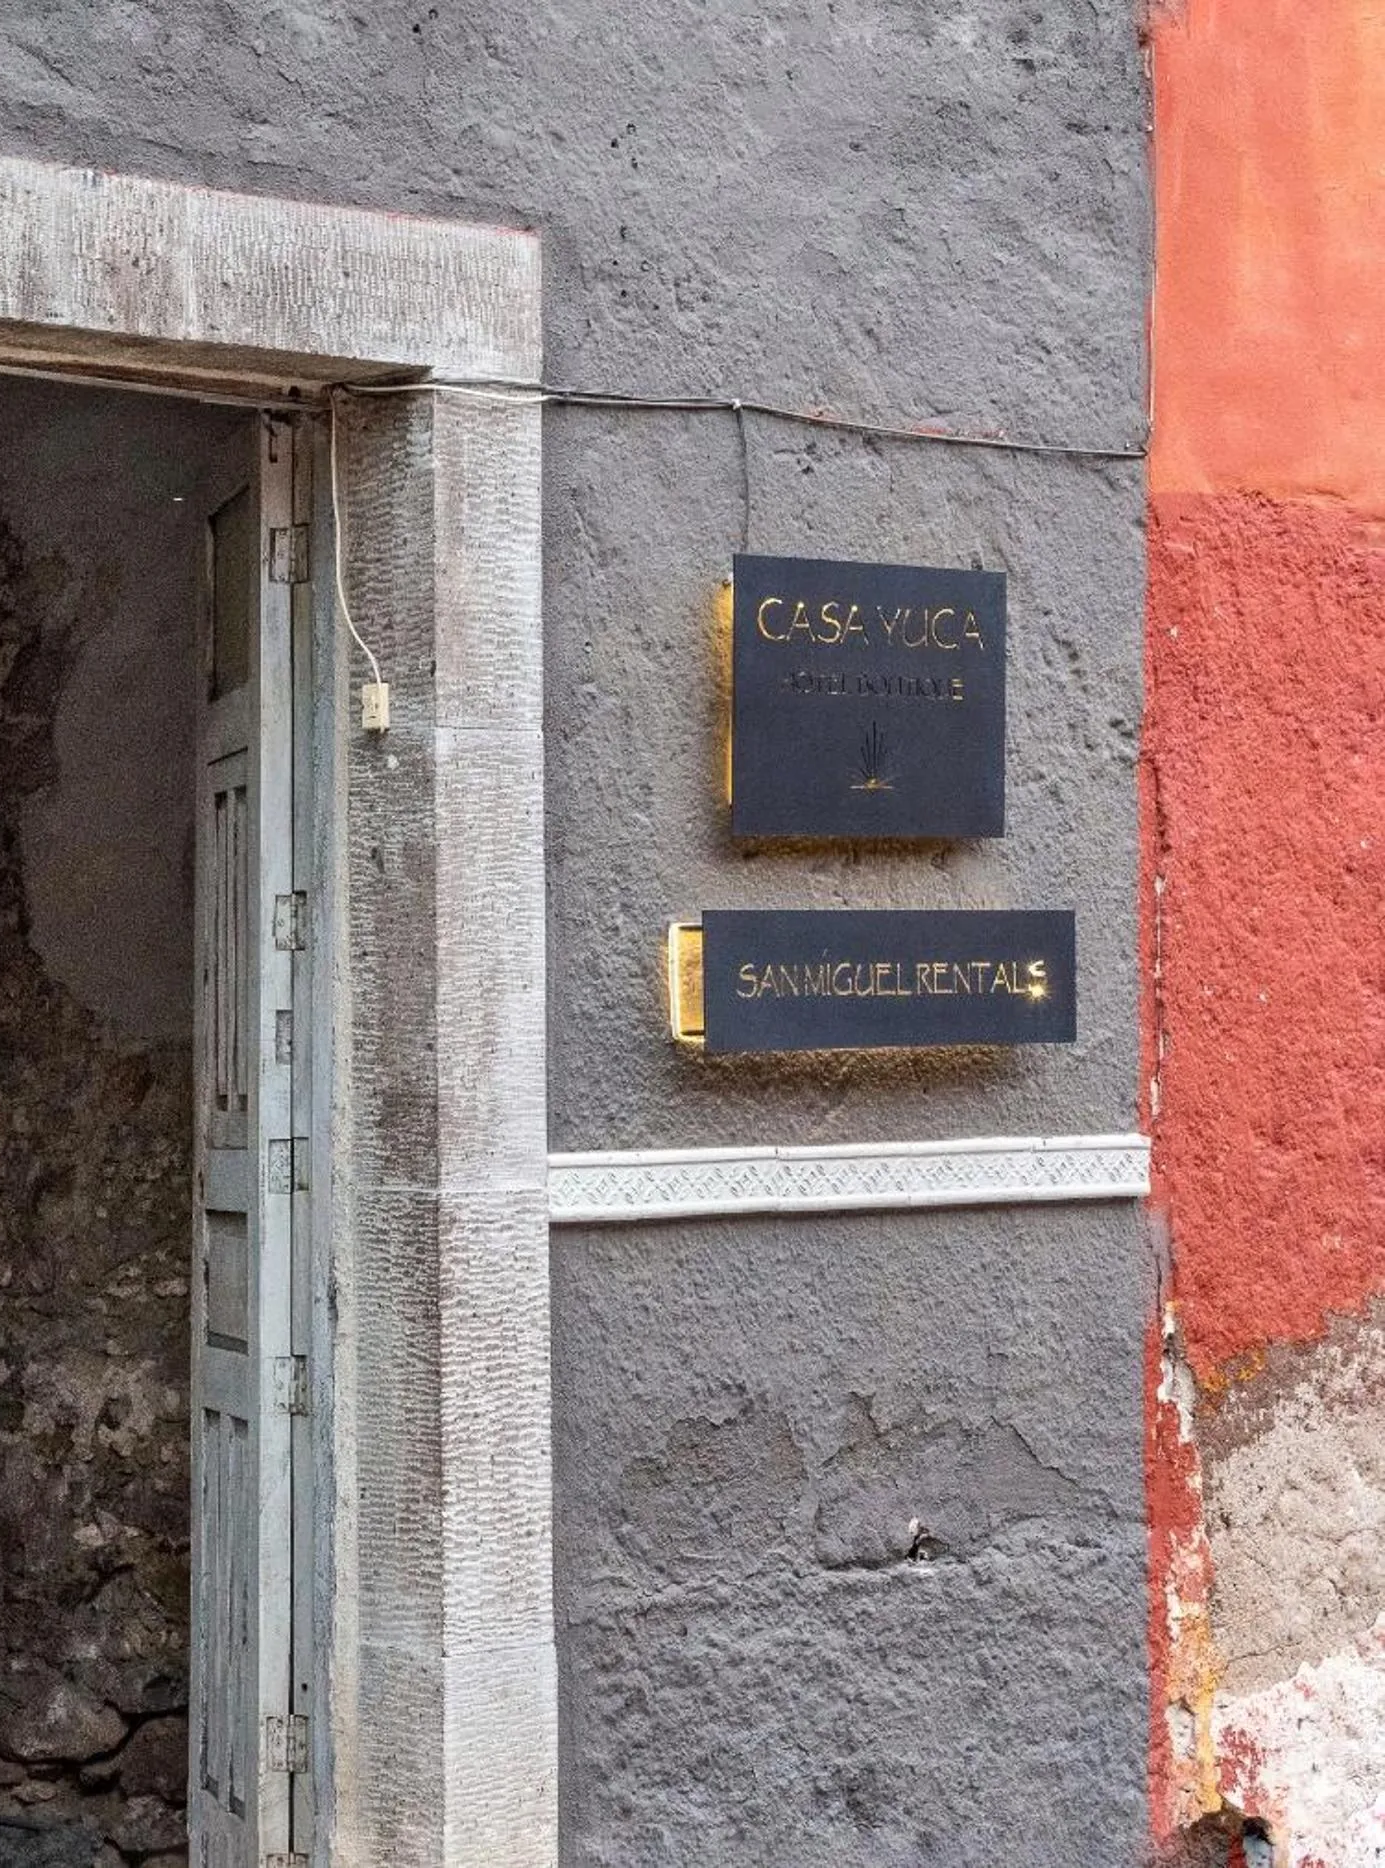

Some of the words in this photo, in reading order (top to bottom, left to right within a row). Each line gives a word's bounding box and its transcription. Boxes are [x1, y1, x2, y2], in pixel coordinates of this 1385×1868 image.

[756, 597, 869, 645] CASA
[875, 606, 984, 650] YUCA
[735, 962, 799, 998] SAN
[916, 960, 1049, 1000] RENTALS
